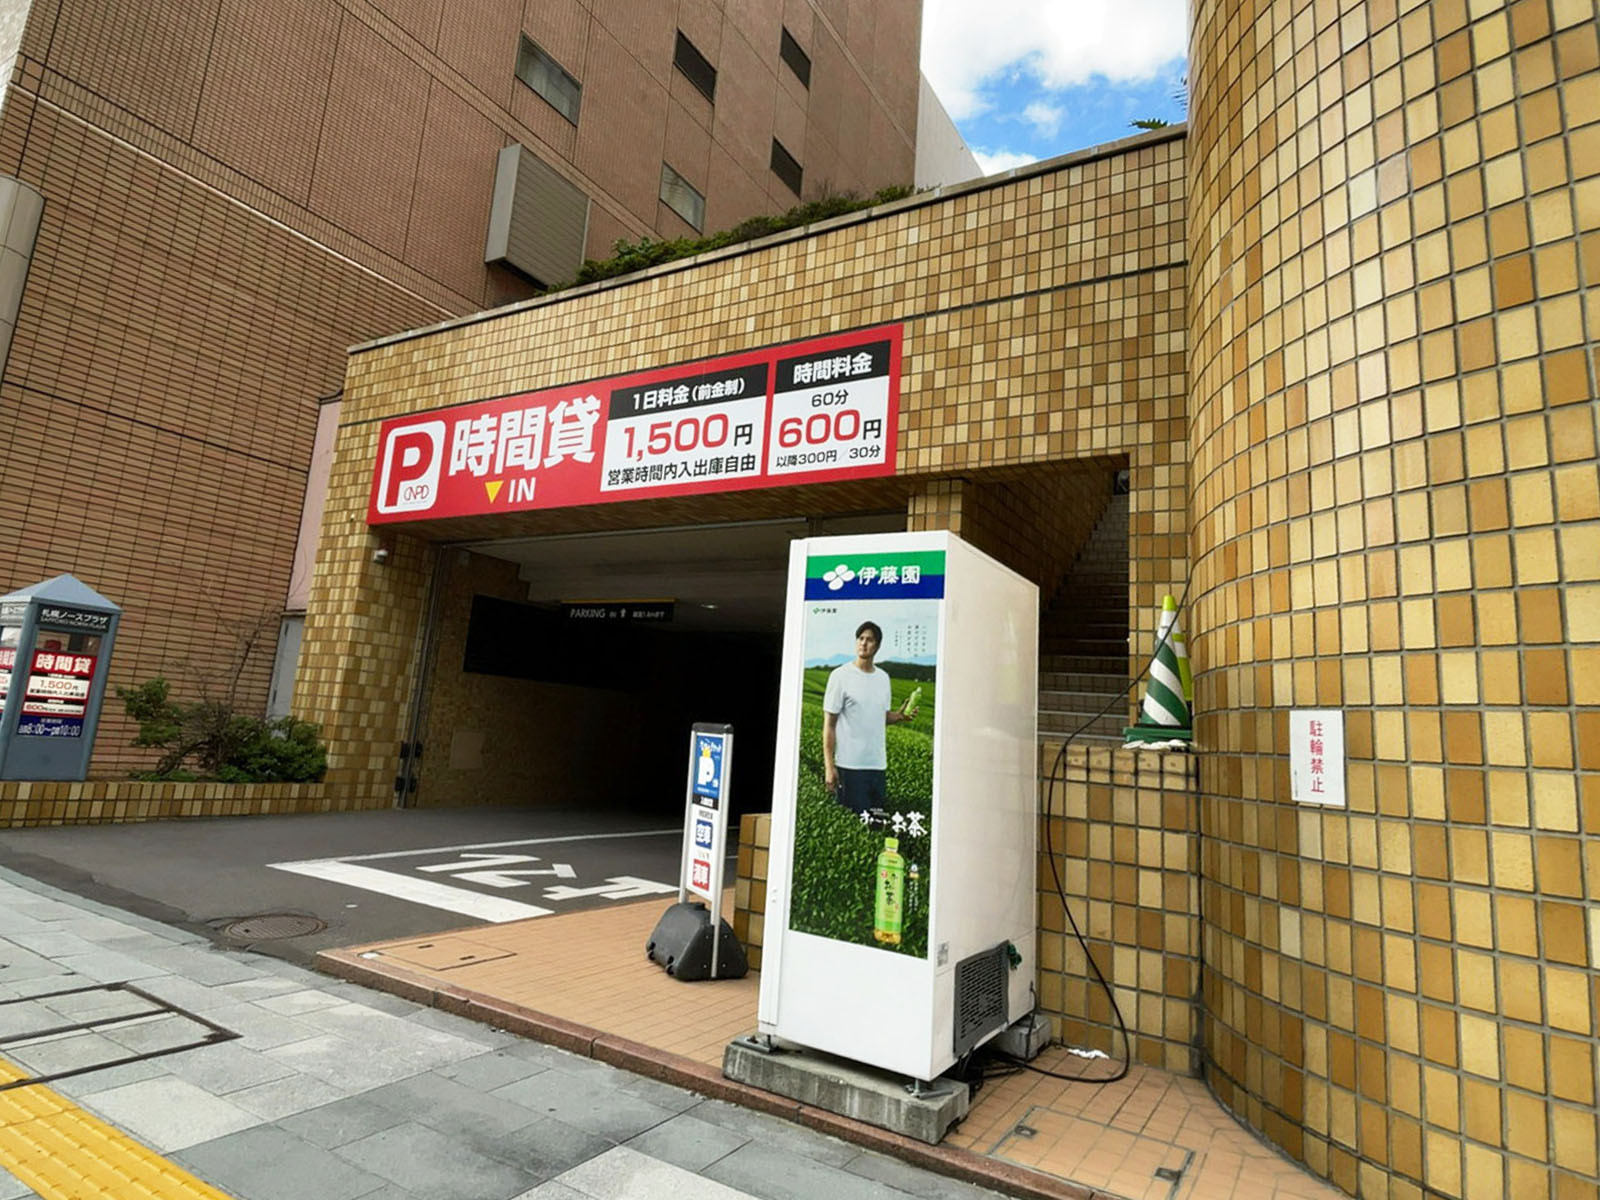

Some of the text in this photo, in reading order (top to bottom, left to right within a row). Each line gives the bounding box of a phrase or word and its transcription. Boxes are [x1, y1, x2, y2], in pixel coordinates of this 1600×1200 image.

[793, 351, 873, 384] 時間料金
[811, 388, 849, 408] 60分
[449, 395, 601, 477] 時間貸
[623, 412, 753, 461] 1,500円
[778, 411, 881, 449] 600円
[384, 431, 434, 507] P
[607, 454, 757, 487] 営業時間内入出庫自由
[507, 478, 536, 503] IN
[857, 565, 921, 586] 伊藤園
[41, 609, 109, 624] 札幌ノースプラザ
[570, 608, 606, 618] PARKING
[35, 653, 92, 674] 時間貸
[1309, 720, 1325, 794] 駐輪禁止
